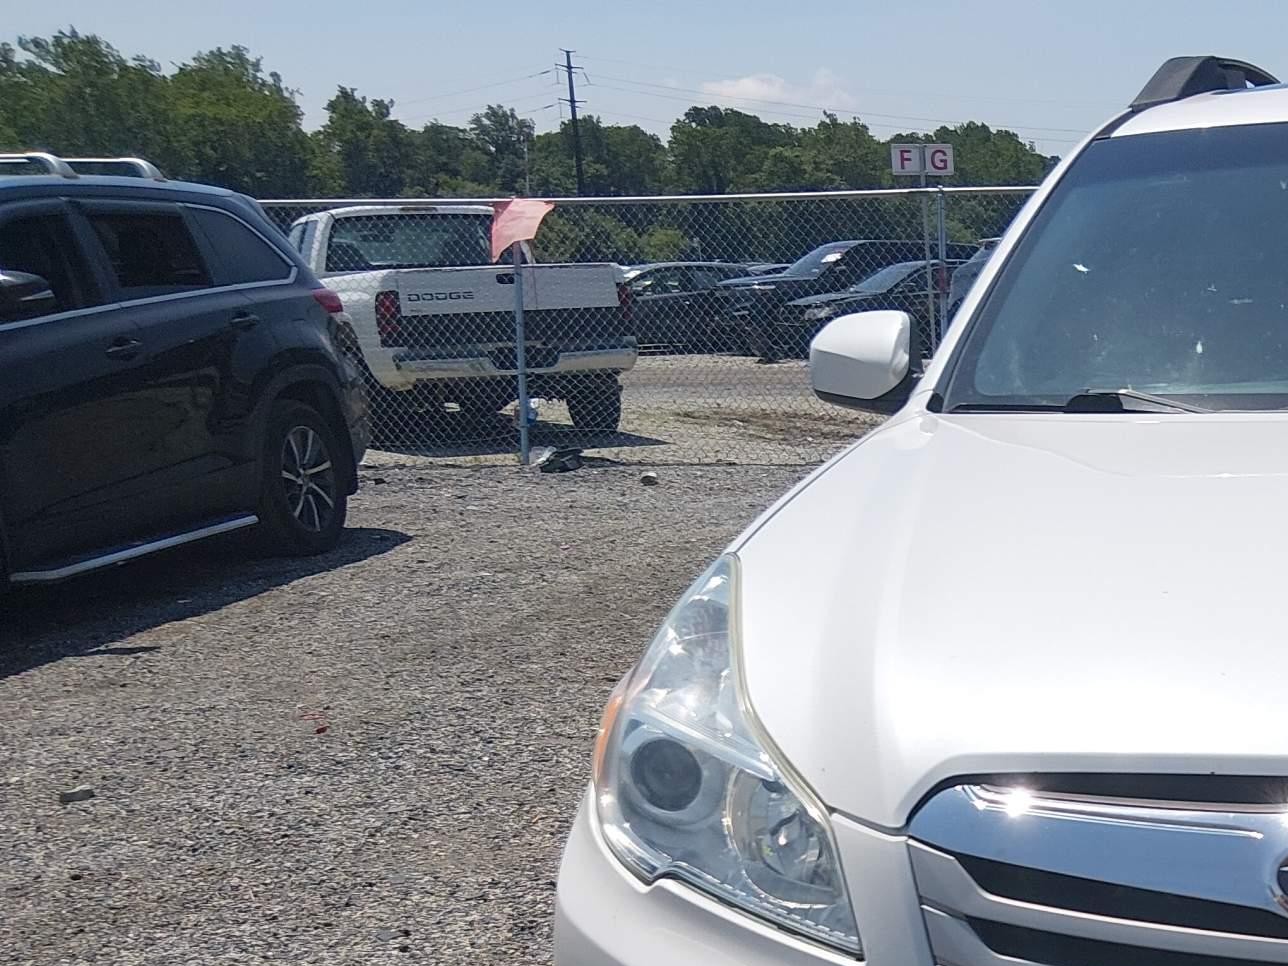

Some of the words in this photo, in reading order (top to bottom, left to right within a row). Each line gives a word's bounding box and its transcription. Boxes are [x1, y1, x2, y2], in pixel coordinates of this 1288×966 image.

[898, 149, 913, 170] F
[930, 149, 948, 171] G
[407, 291, 475, 302] DODGE
